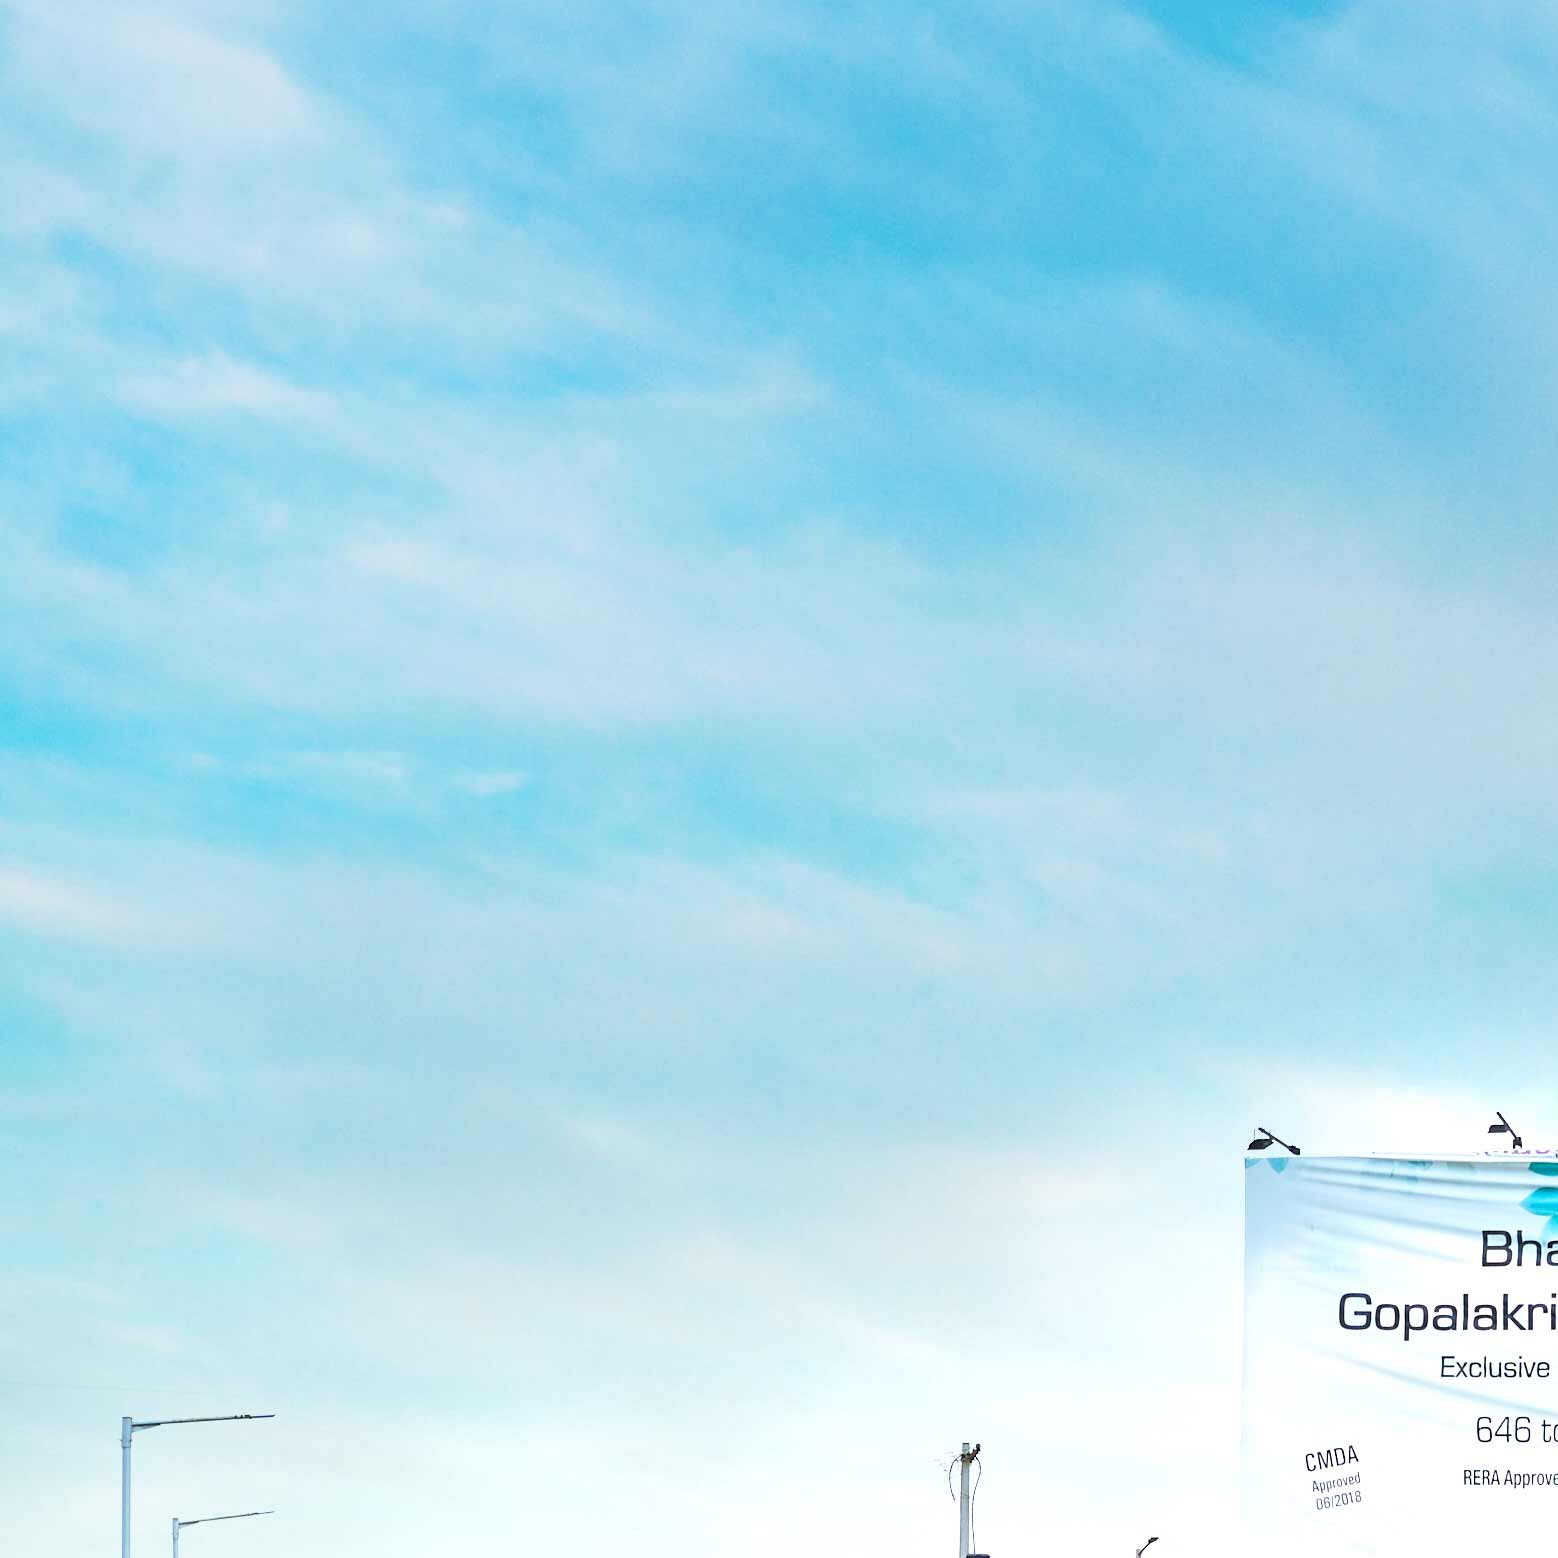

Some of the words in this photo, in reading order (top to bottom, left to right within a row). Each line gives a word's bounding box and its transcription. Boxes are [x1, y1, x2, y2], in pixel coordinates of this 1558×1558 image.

[1440, 1355, 1550, 1378] Exclusive
[1476, 1416, 1531, 1443] 646
[1305, 1445, 1359, 1471] CMDA
[1312, 1472, 1361, 1493] Approved
[1463, 1469, 1500, 1486] RERA
[1316, 1490, 1362, 1510] 06/2018
